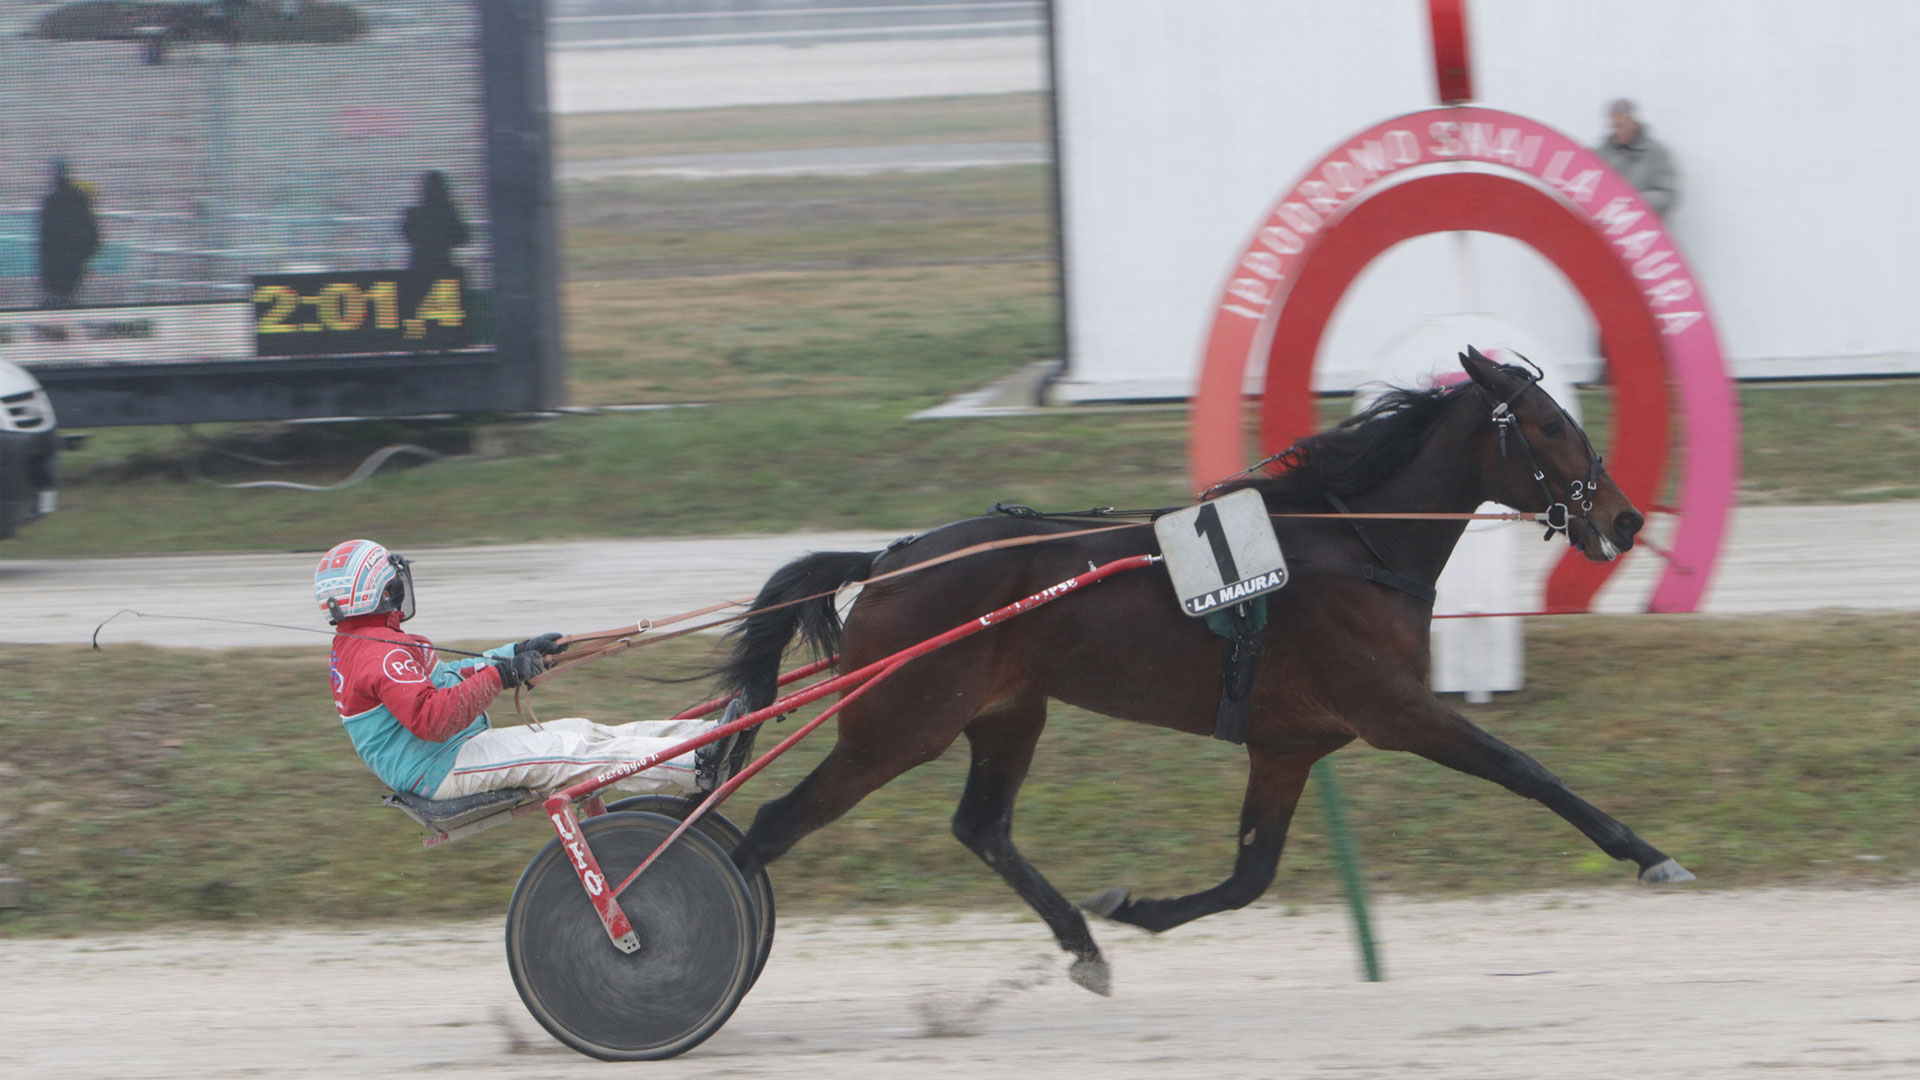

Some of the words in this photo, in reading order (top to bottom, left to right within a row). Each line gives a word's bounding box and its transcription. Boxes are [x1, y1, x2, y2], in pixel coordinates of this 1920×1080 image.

[1221, 130, 1421, 319] IPPODROMO
[1427, 121, 1544, 168] SNAI
[1541, 151, 1604, 202] LA
[1592, 197, 1704, 335] MAURA
[1194, 502, 1241, 586] 1
[1194, 594, 1217, 612] LA
[1219, 571, 1281, 603] MAURA
[392, 659, 419, 676] PG
